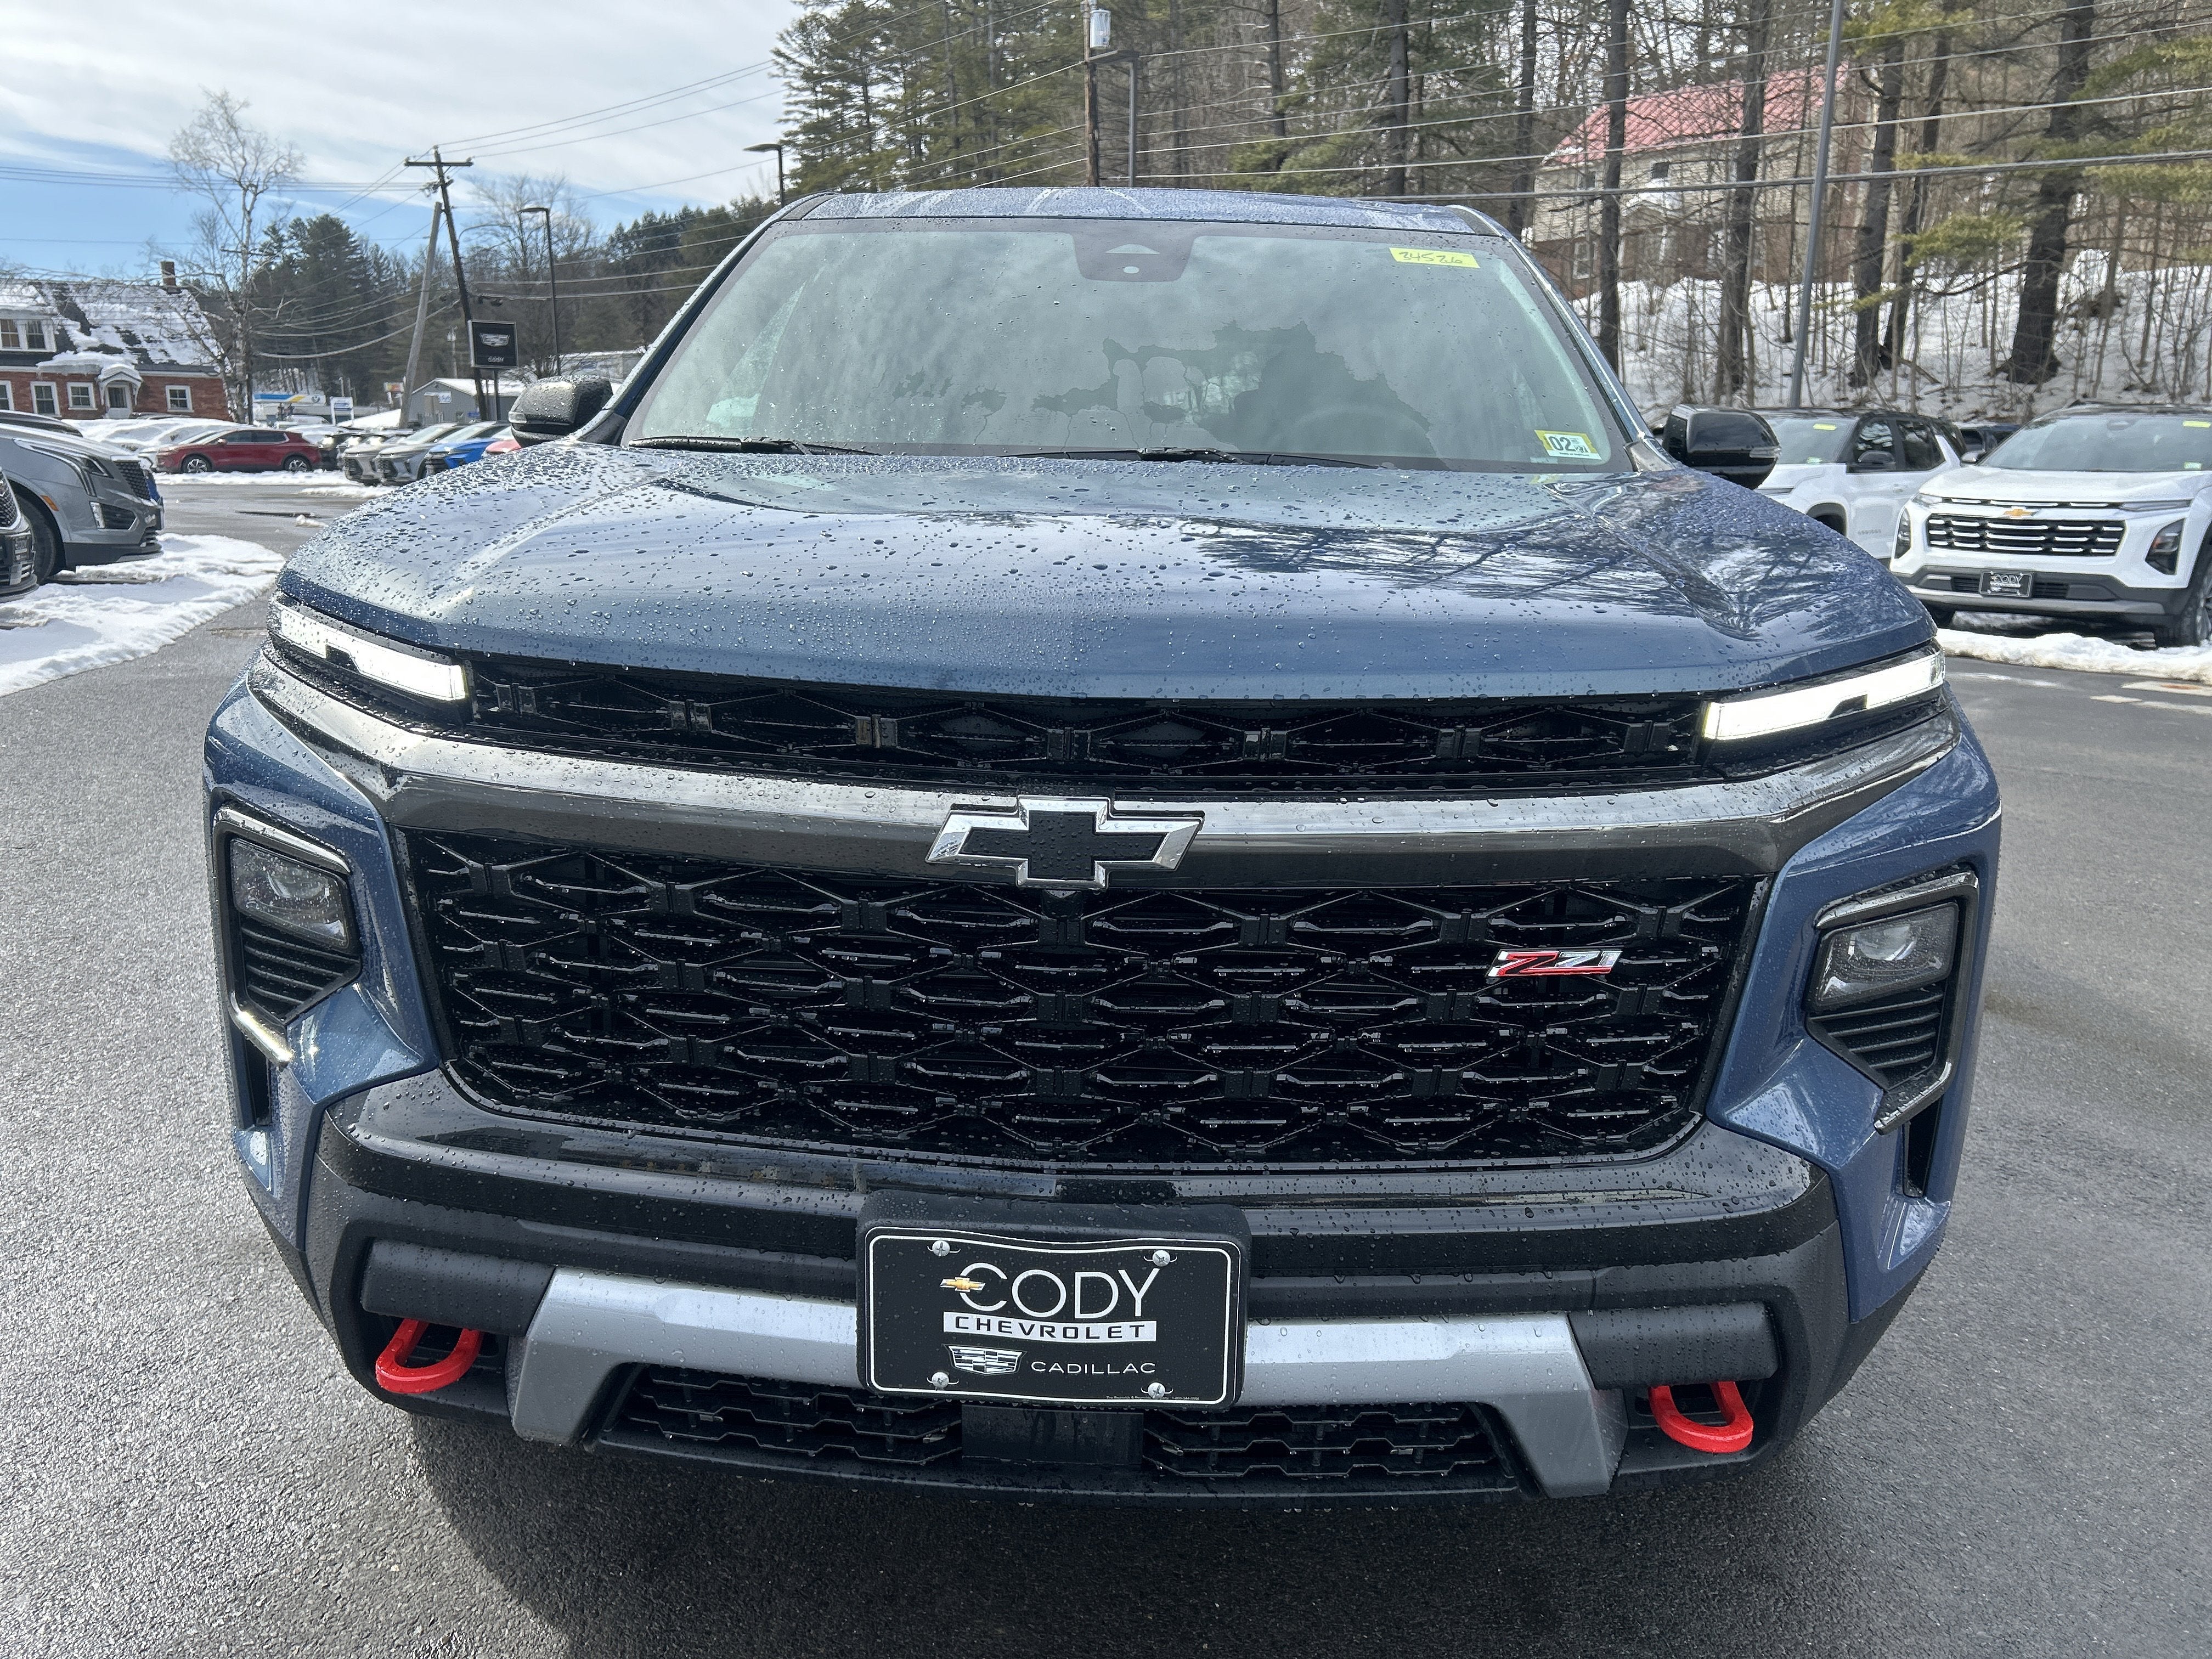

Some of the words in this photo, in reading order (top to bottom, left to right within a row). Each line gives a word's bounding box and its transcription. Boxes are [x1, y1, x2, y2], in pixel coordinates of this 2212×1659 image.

[1549, 436, 1576, 452] 02
[1993, 574, 2023, 585] CODY
[958, 1262, 1160, 1319] CODY
[955, 1316, 1145, 1340] CHEVROLET
[1031, 1361, 1156, 1374] CADILLAC
